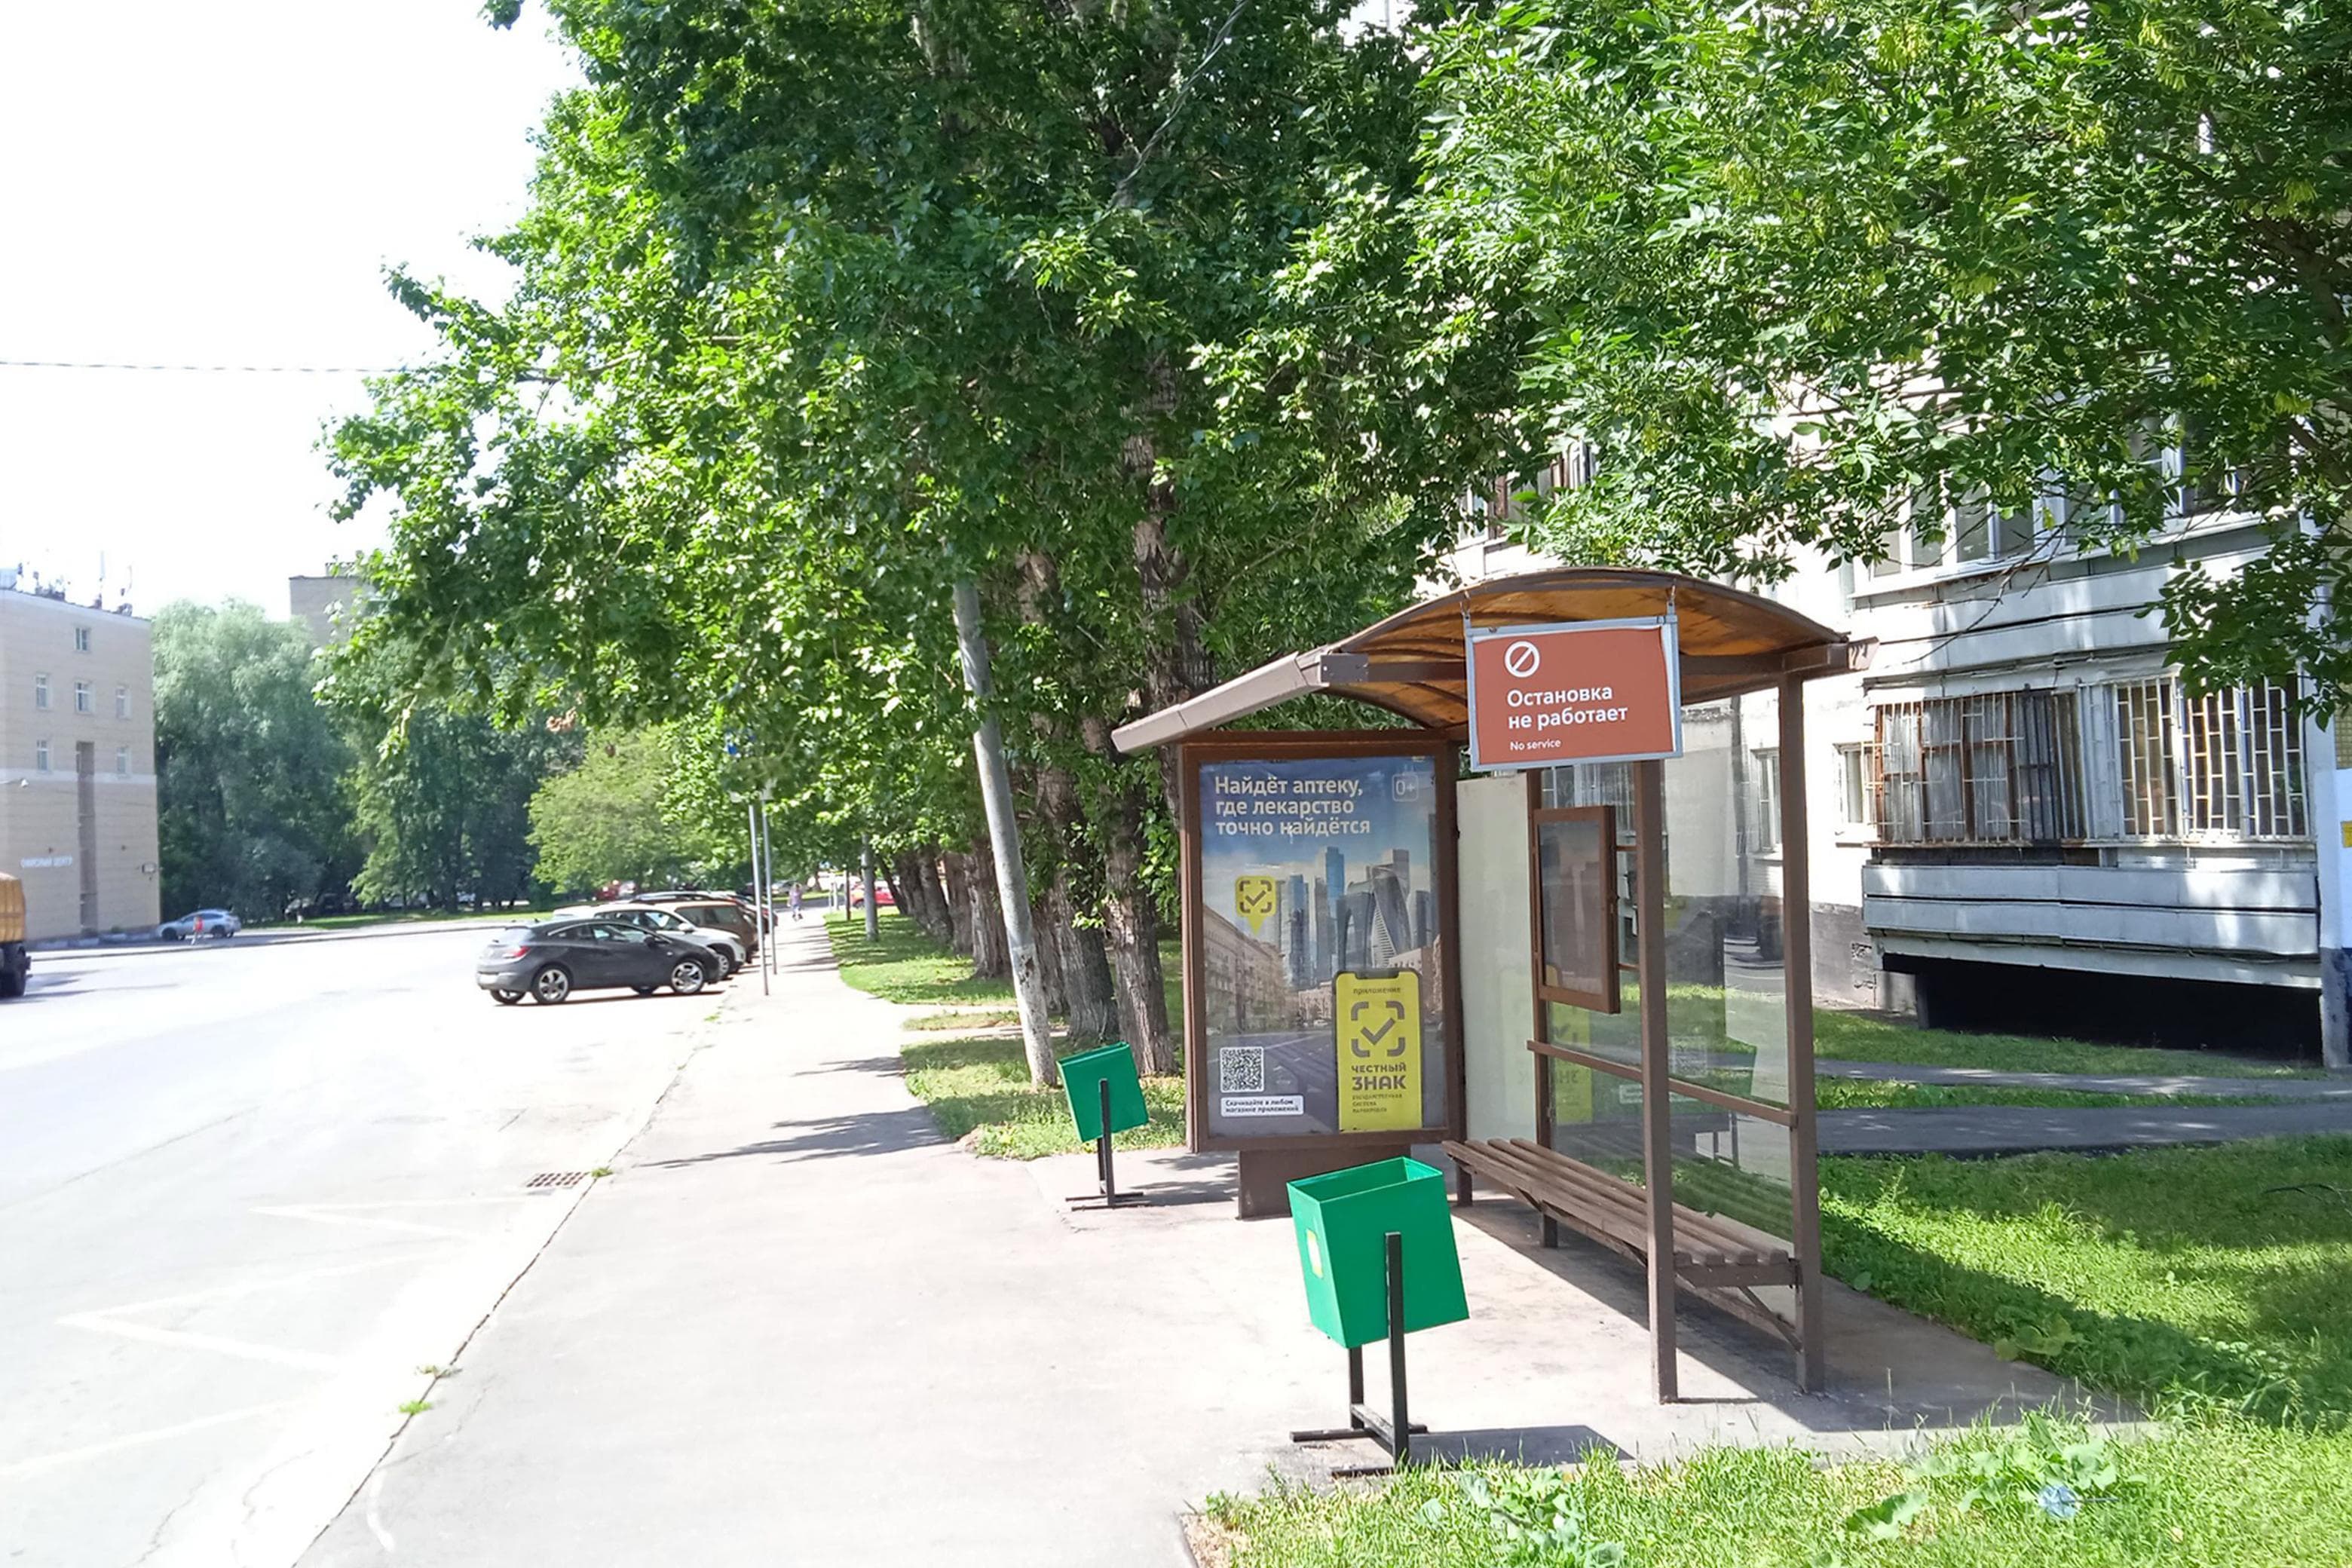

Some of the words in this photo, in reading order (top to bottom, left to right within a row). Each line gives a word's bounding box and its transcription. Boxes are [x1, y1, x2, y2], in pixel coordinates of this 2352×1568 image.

[1507, 686, 1613, 707] Остановка
[1508, 713, 1532, 729] не
[1538, 706, 1628, 730] работает
[1510, 740, 1525, 751] No
[1527, 739, 1561, 750] service
[1214, 776, 1288, 796] Найдёт
[1293, 778, 1363, 798] аптеку,
[1395, 779, 1416, 795] 0+
[1215, 801, 1248, 816] где
[1252, 799, 1355, 818] лекарство
[1215, 820, 1273, 836] точно
[1280, 816, 1370, 837] найдётся
[1351, 1061, 1407, 1073] ЧЕСТНЫЙ
[1352, 1075, 1407, 1091] ЗНАК
